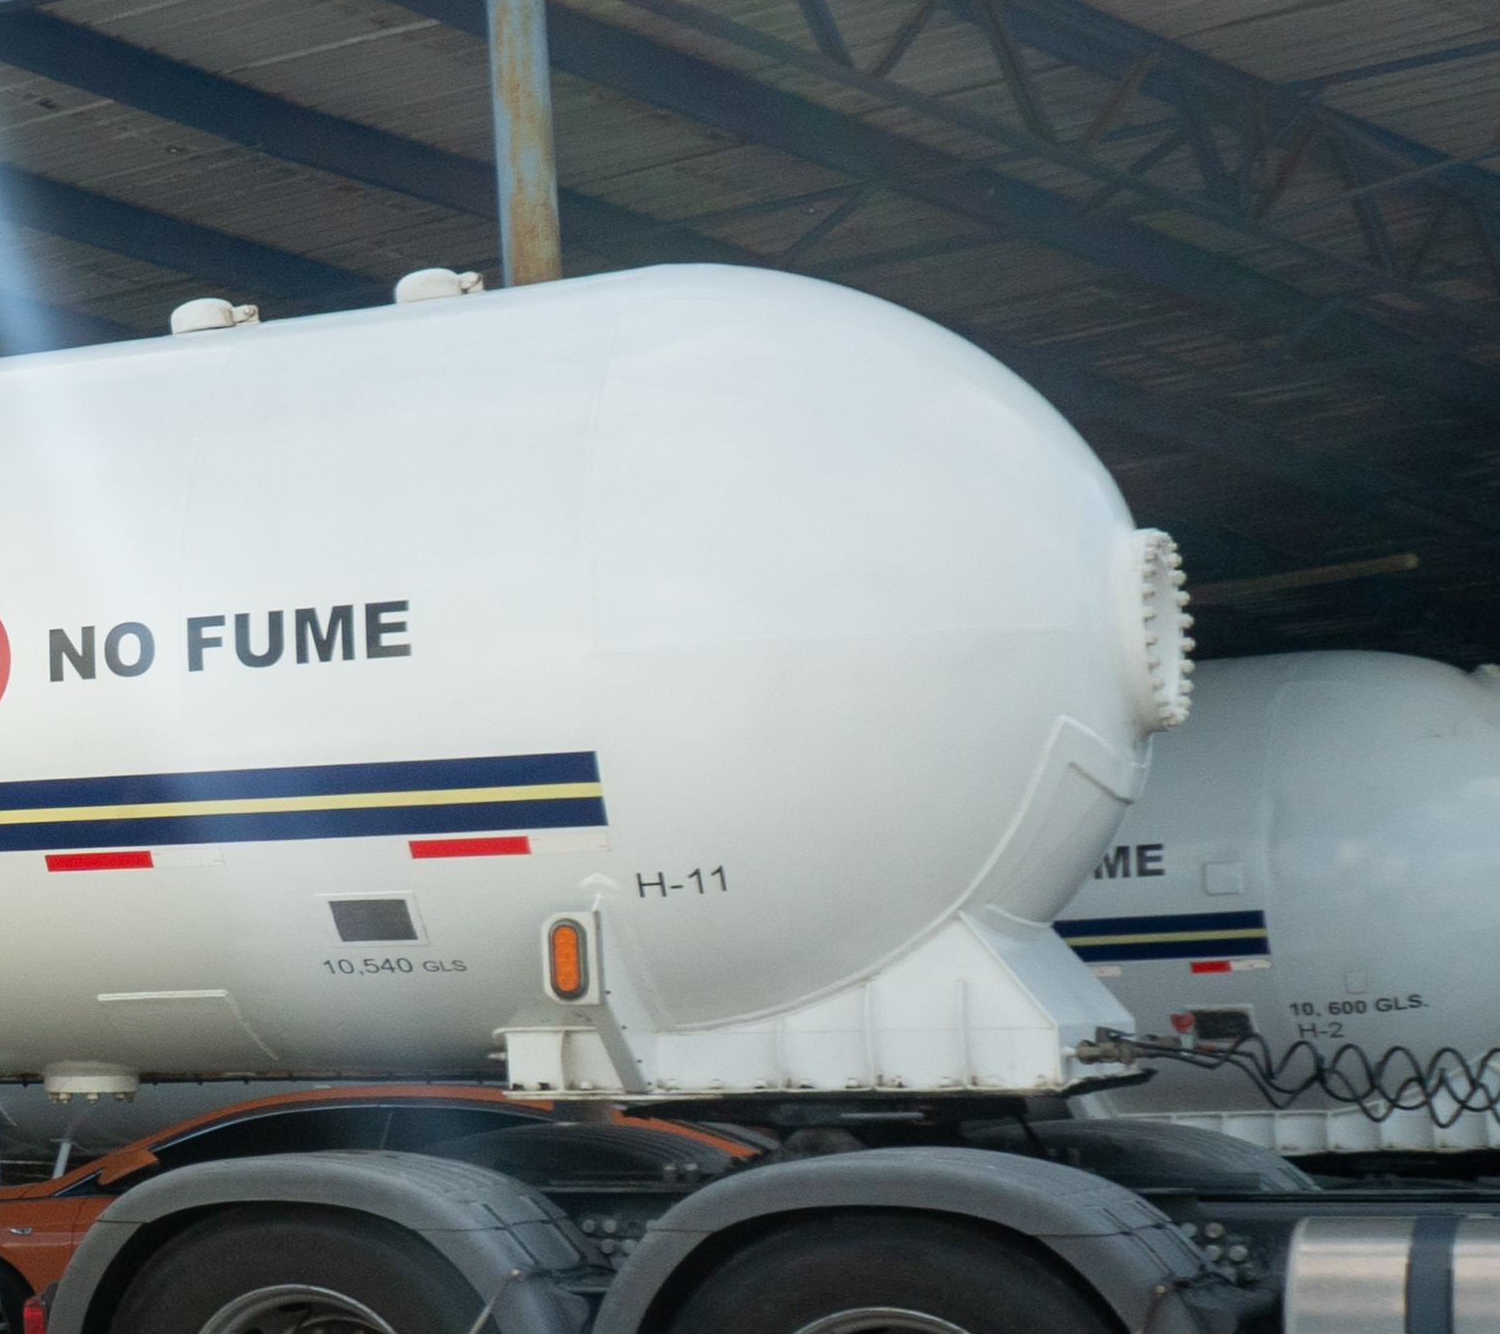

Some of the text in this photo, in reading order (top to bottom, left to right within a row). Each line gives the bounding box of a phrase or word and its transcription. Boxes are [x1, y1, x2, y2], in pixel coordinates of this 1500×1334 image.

[49, 600, 411, 683] NO FUME
[1094, 843, 1165, 880] ME
[635, 865, 728, 899] H-11
[322, 957, 469, 976] 10,540 GLS
[1297, 1021, 1344, 1039] H-2
